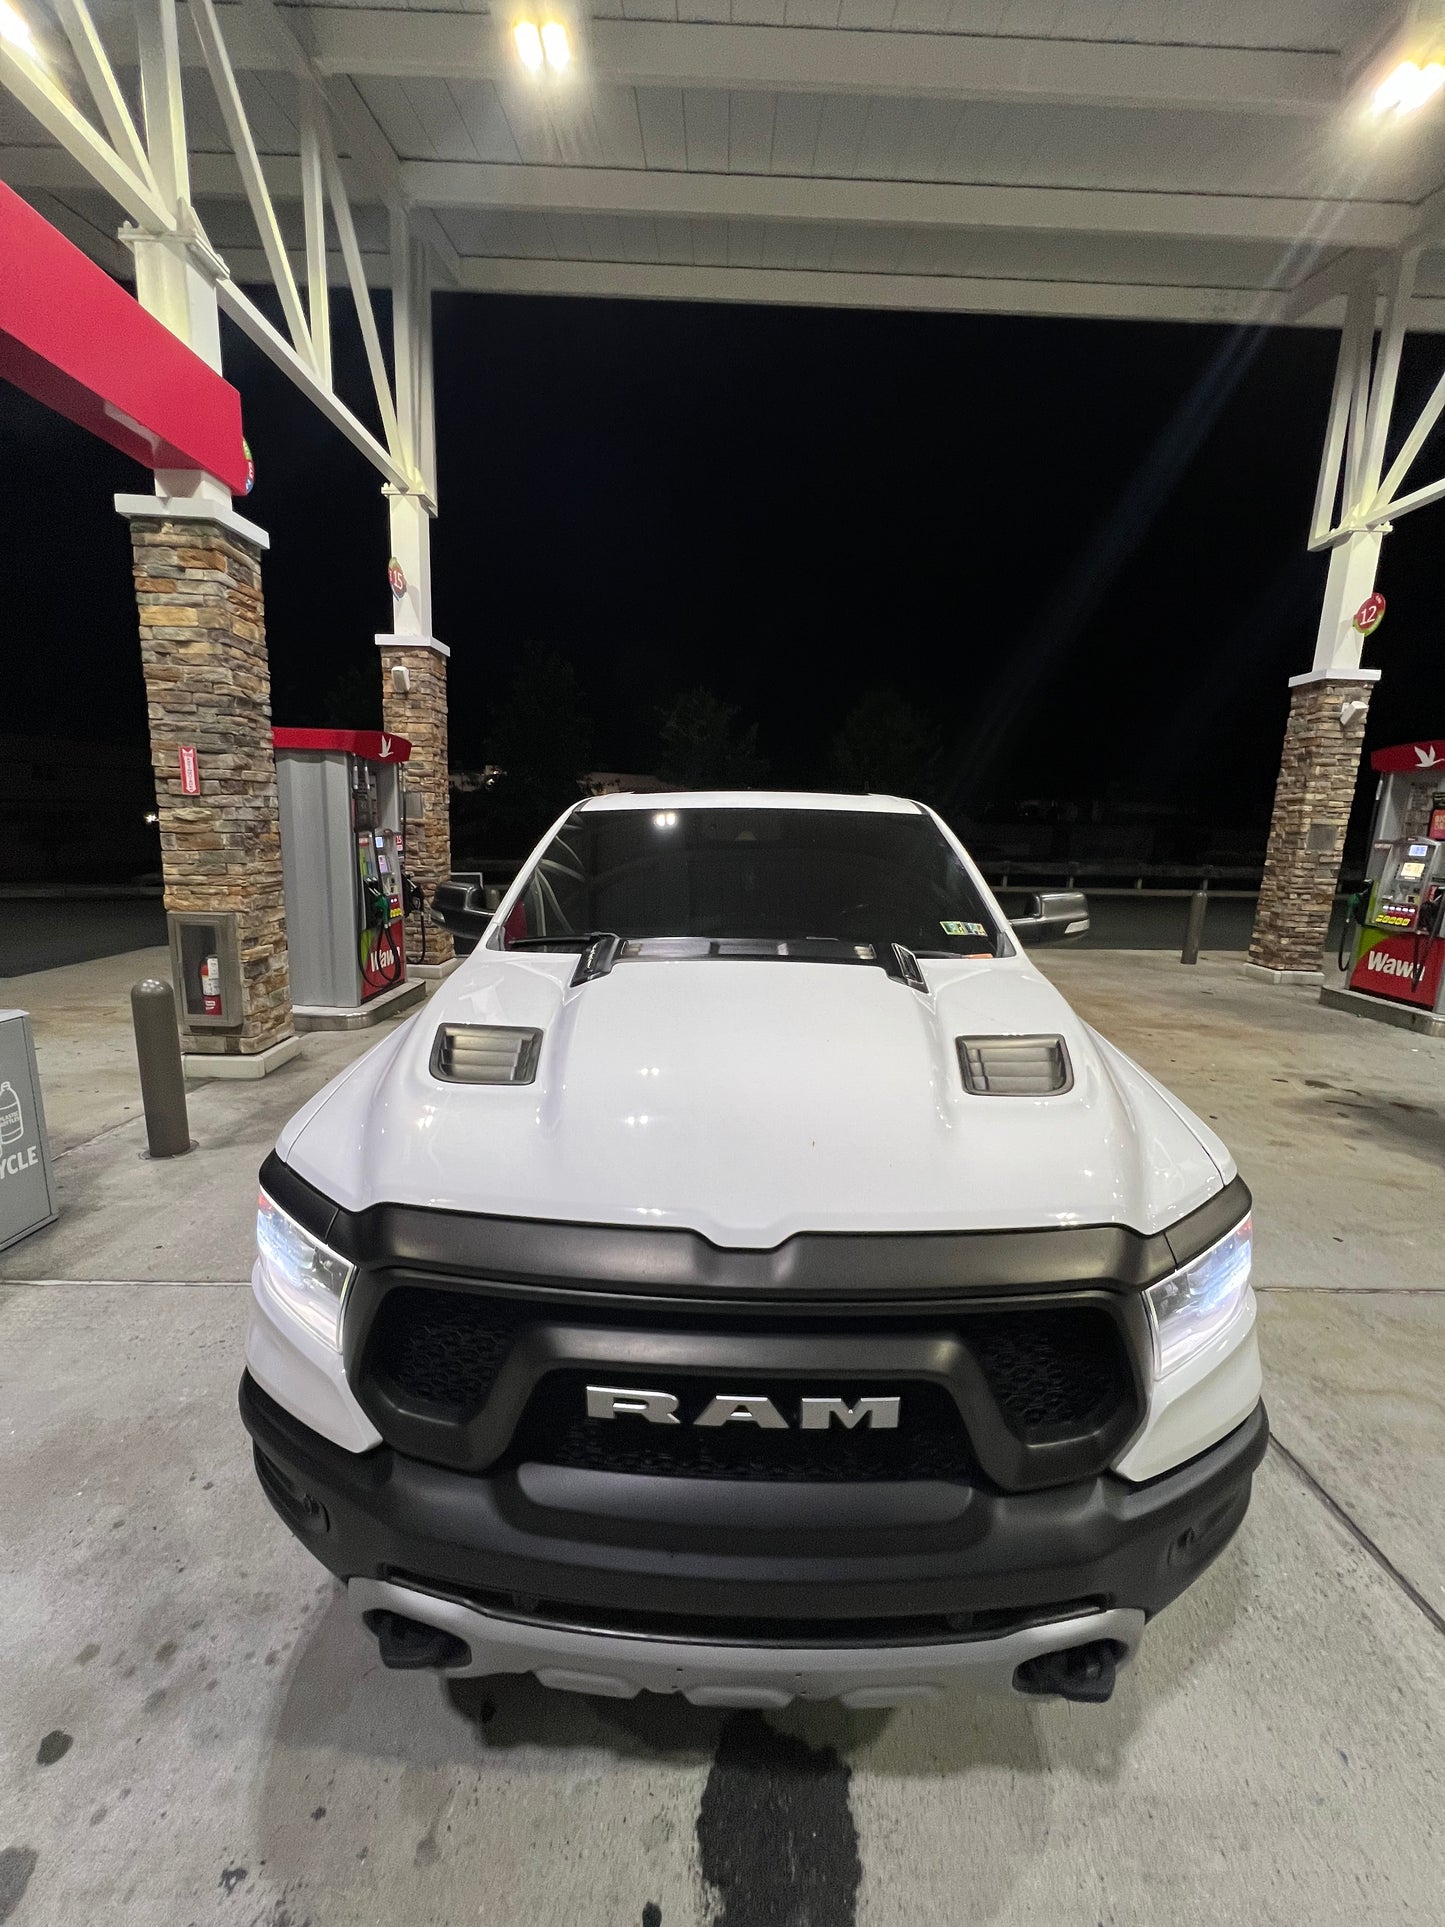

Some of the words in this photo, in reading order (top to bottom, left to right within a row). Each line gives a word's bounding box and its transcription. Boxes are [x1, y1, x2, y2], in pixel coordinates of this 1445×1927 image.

[394, 570, 403, 590] 15
[1360, 605, 1377, 626] 12
[370, 946, 401, 972] Waw
[586, 1386, 901, 1429] RAM
